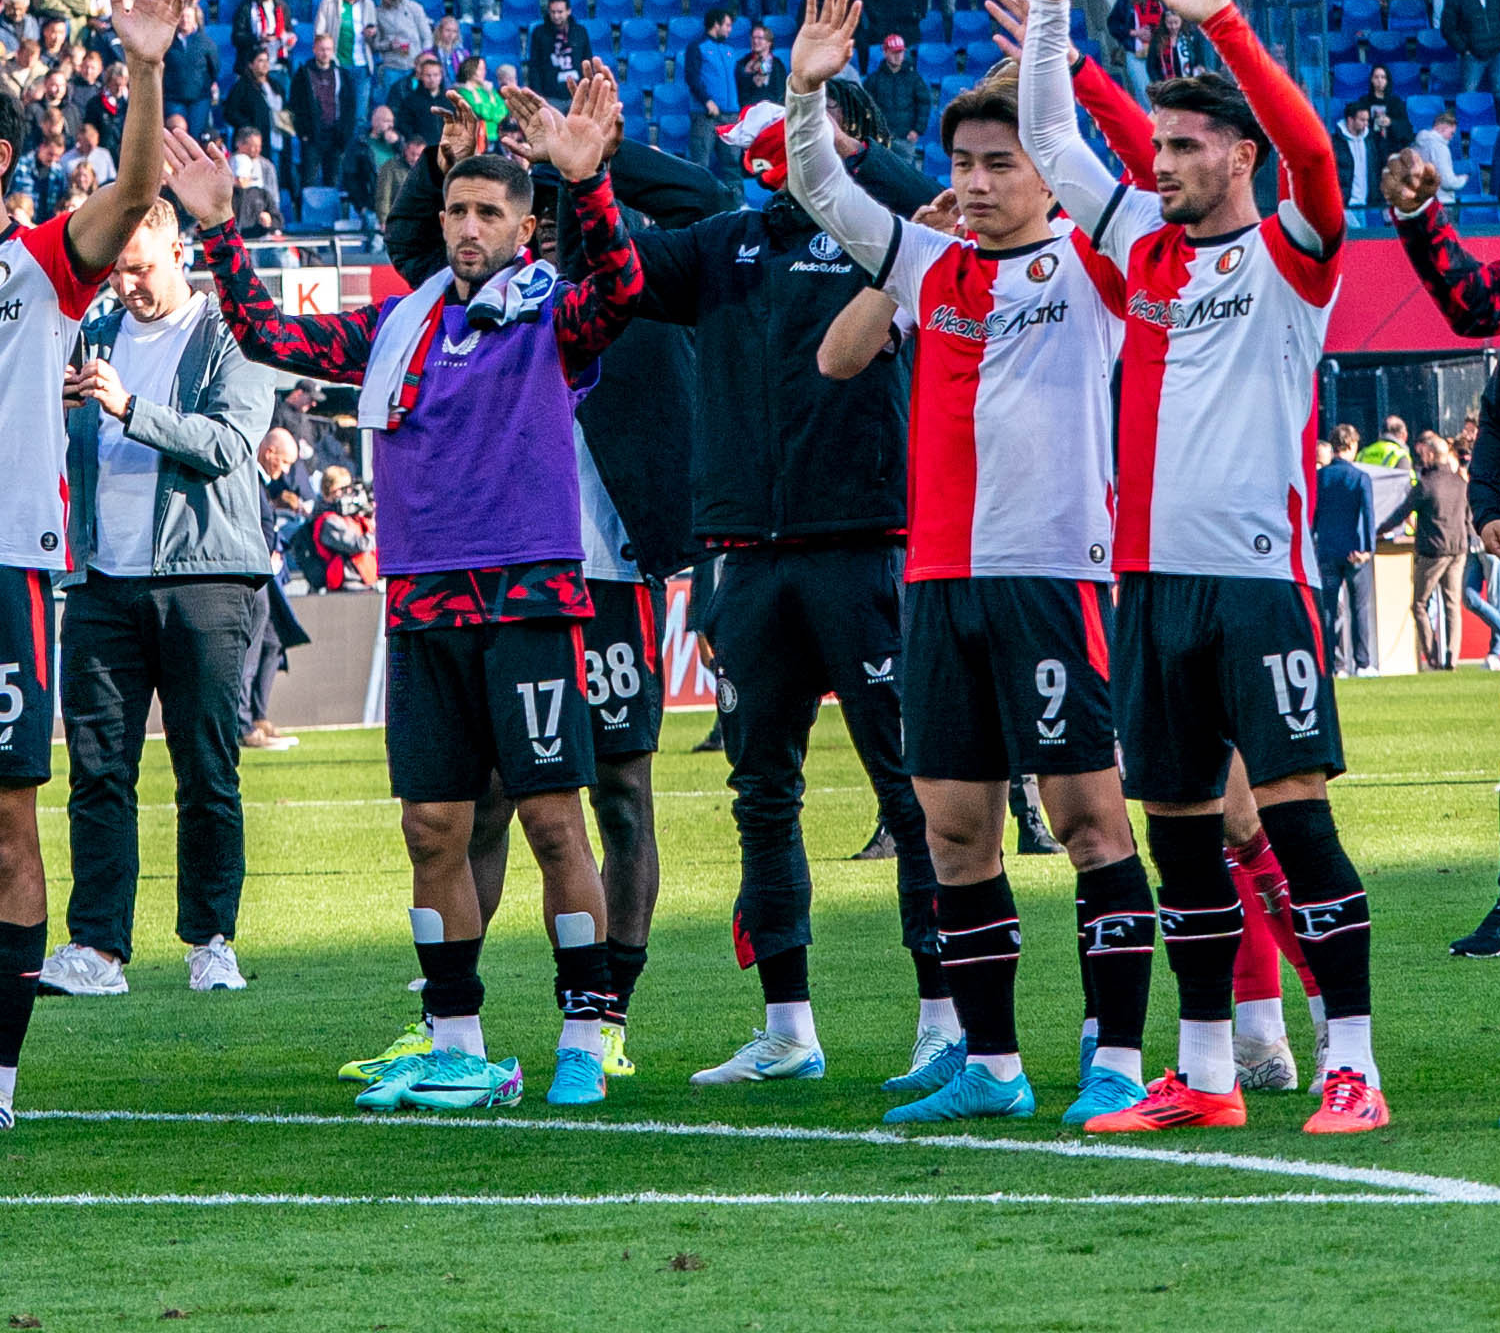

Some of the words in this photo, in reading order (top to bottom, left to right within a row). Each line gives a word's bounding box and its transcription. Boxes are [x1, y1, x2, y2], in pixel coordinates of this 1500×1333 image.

[298, 283, 320, 314] K
[1185, 293, 1254, 329] Markt
[585, 642, 640, 705] 38
[1035, 658, 1067, 719] 9
[1262, 649, 1319, 716] 19
[516, 679, 566, 739] 17
